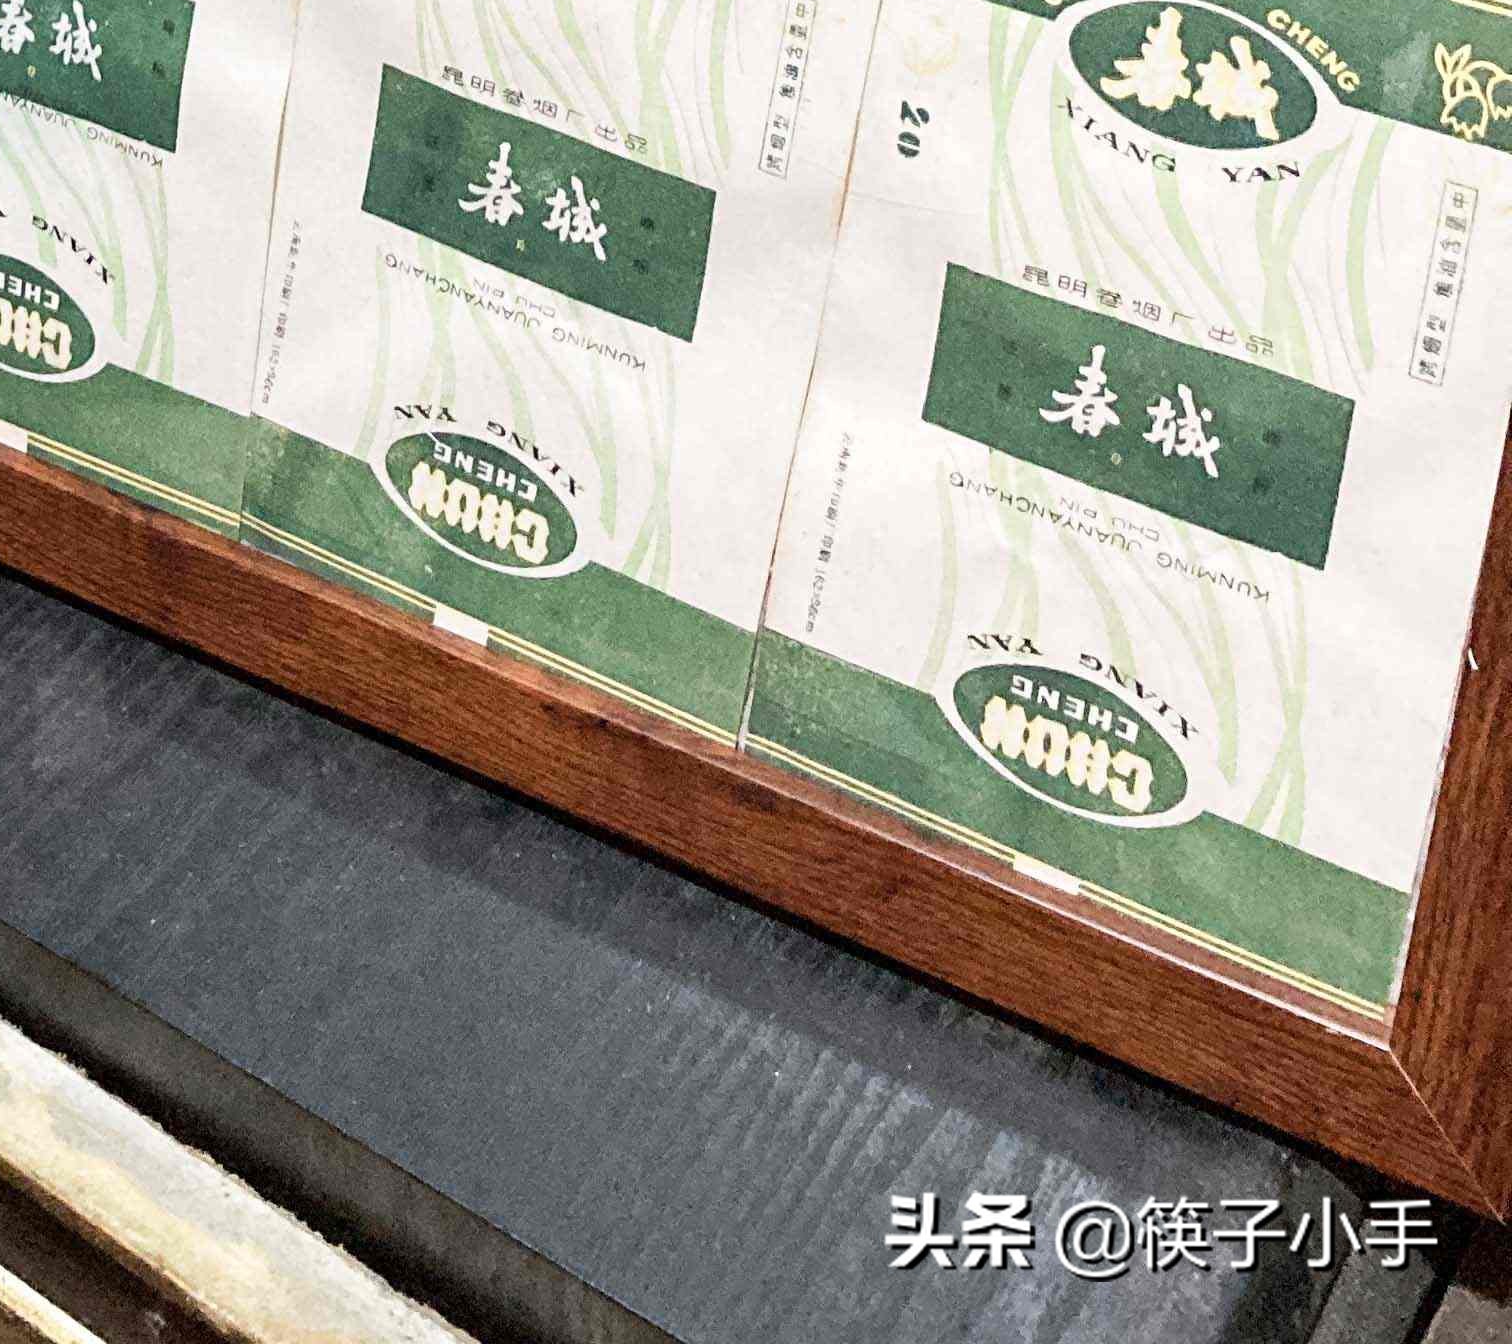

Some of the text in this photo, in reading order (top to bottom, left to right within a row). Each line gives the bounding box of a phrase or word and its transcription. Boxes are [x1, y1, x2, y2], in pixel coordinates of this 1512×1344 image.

[1266, 7, 1360, 94] CHENG
[1058, 95, 1302, 185] XIANG YAN
[458, 141, 608, 260] 春城
[32, 214, 116, 285] XIANG
[551, 326, 646, 371] KUNMING
[393, 404, 583, 497] XIANG YAN
[1039, 344, 1221, 478] 春城
[409, 460, 551, 564] CHUN
[432, 442, 538, 501] CHENG
[1156, 552, 1270, 602] KUNMING
[967, 633, 1200, 740] XIANG YAN
[1010, 675, 1139, 743] CHENG
[980, 696, 1153, 812] CHUN
